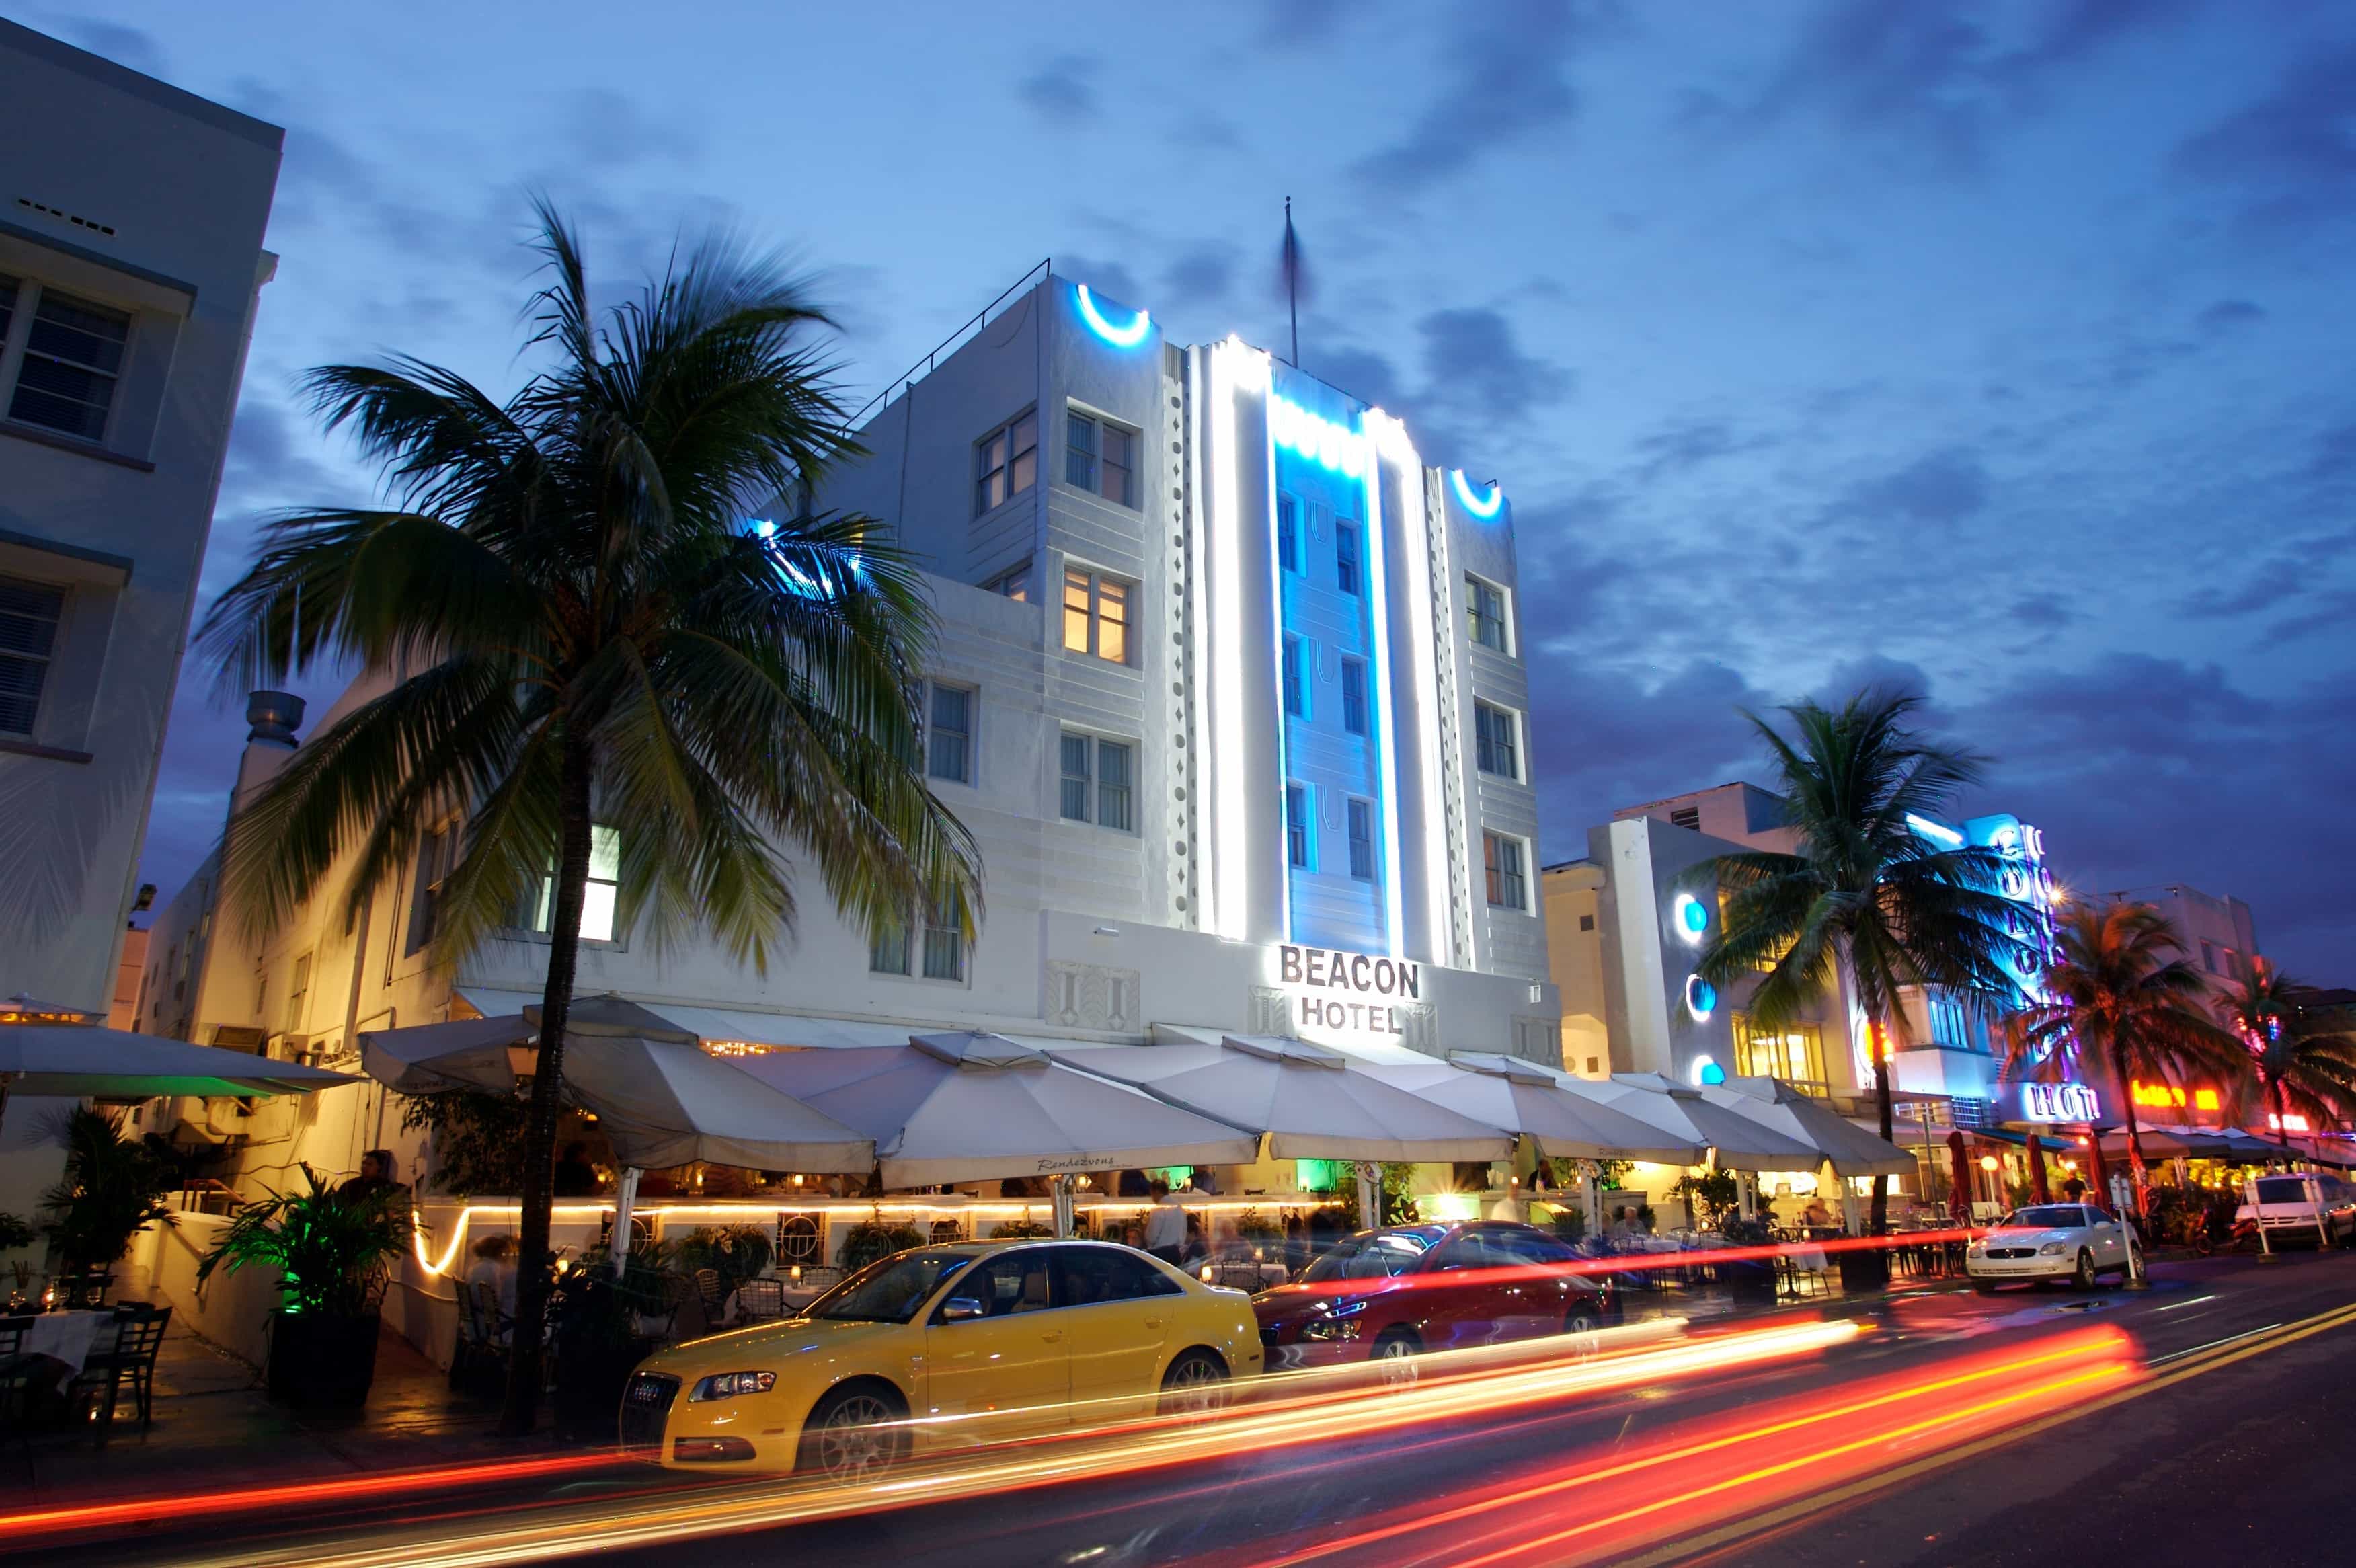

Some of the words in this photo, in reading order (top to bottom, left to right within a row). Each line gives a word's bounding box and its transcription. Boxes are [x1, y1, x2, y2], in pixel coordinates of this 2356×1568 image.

[1280, 945, 1419, 998] BEACON
[1302, 997, 1403, 1035] HOTEL
[1037, 1157, 1114, 1171] Rendezvous
